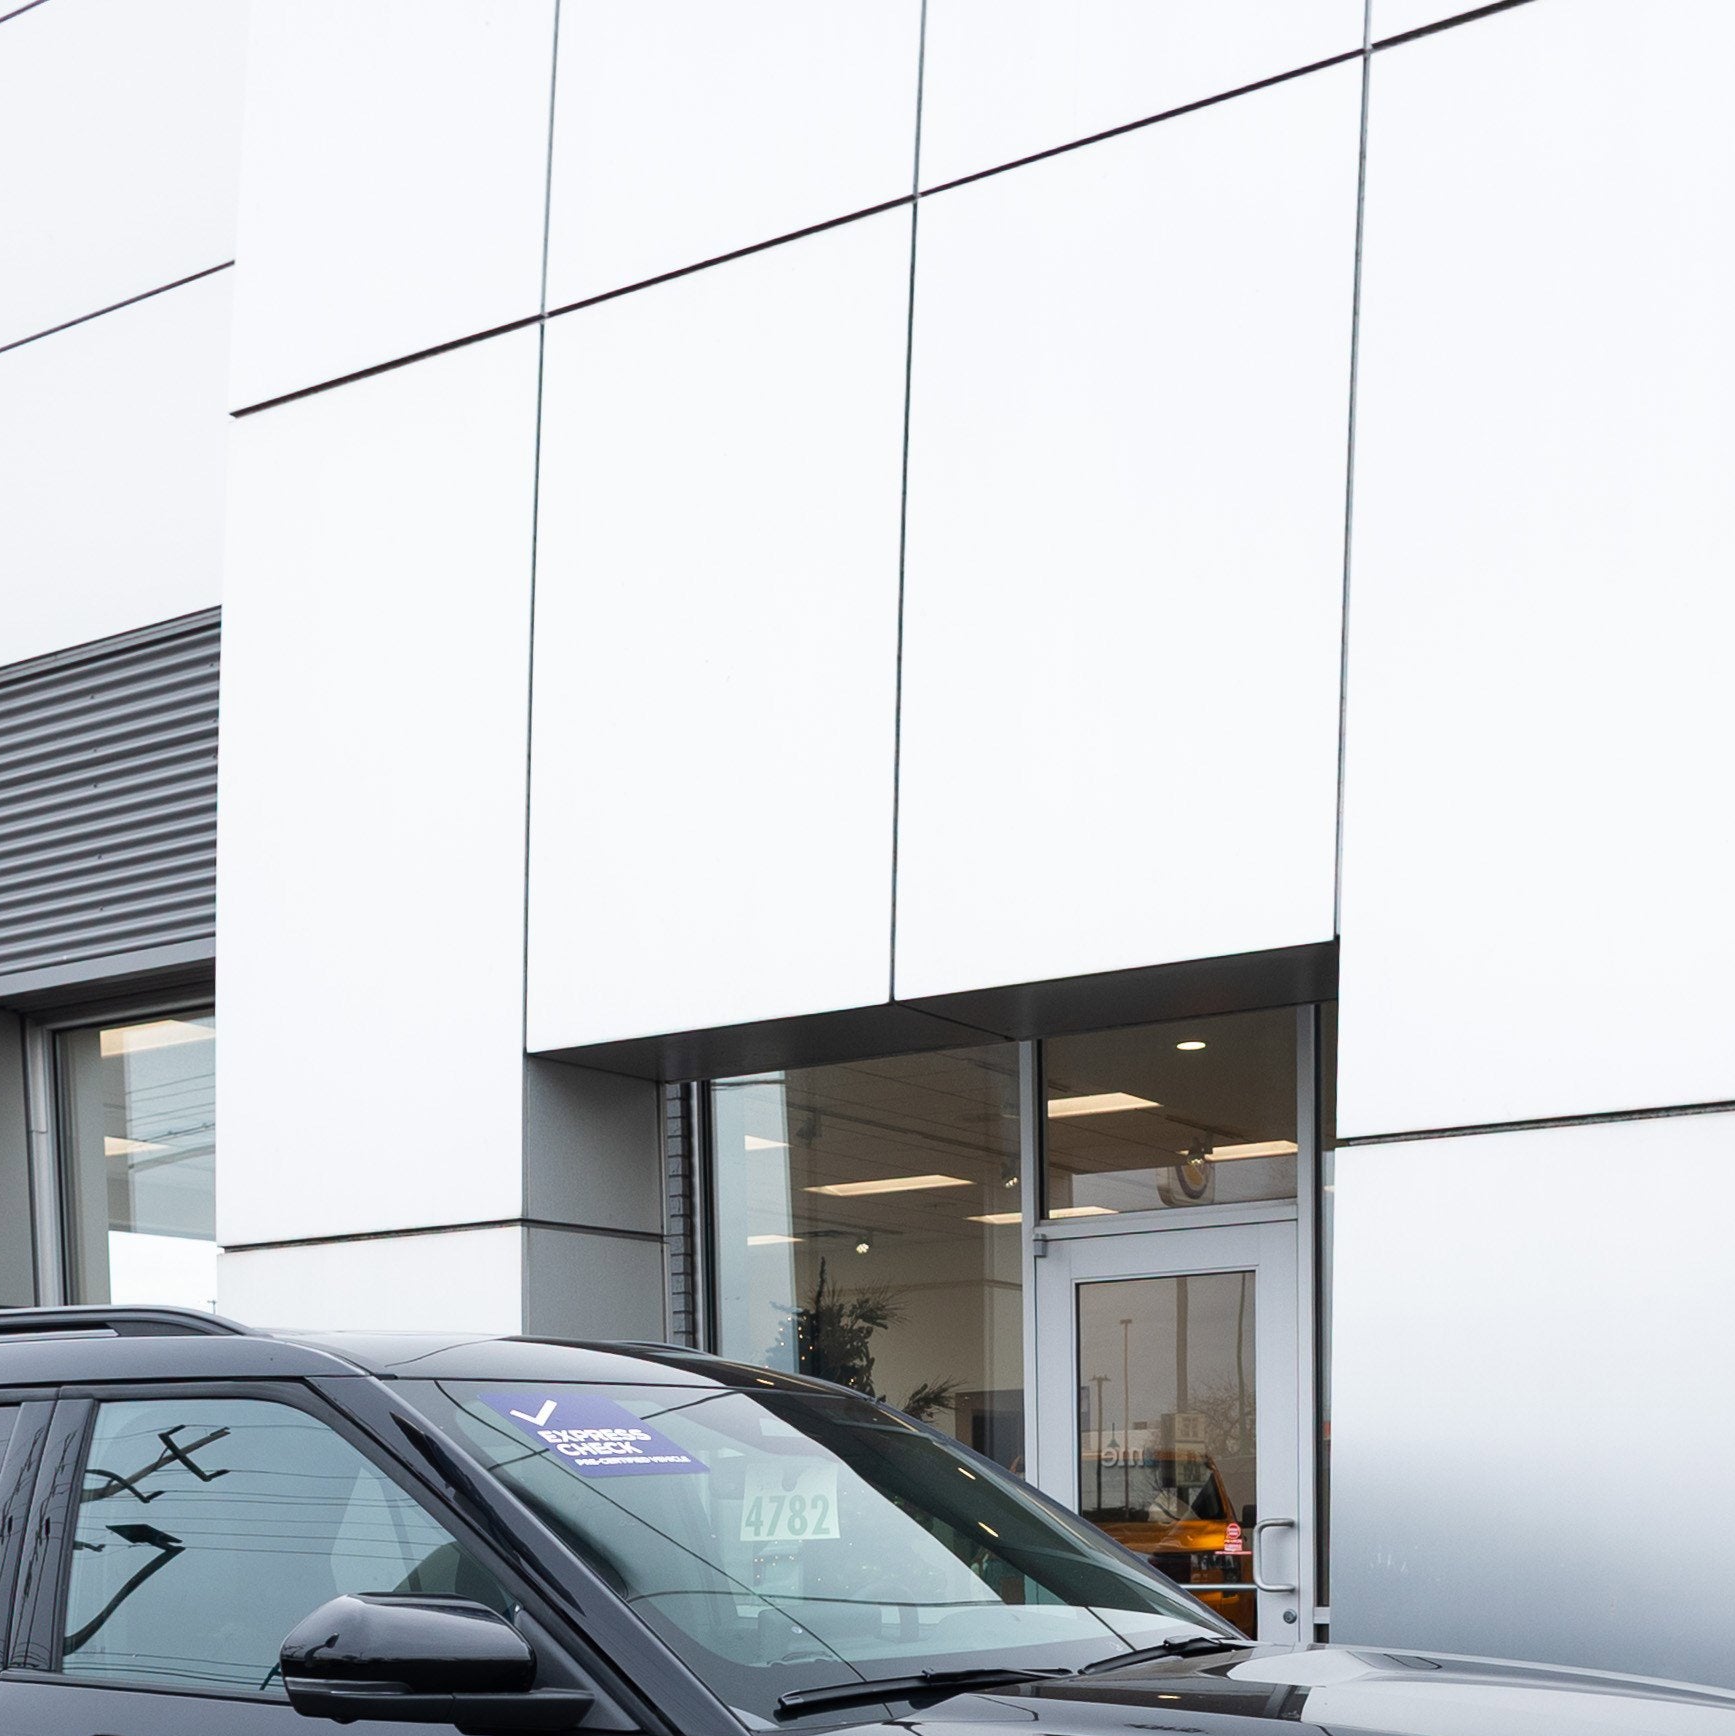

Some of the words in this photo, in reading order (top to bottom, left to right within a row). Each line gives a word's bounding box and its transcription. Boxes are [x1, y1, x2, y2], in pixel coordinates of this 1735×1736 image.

[537, 1428, 652, 1444] EXPRESS
[556, 1441, 644, 1456] CHECK
[744, 1494, 831, 1537] 4782
